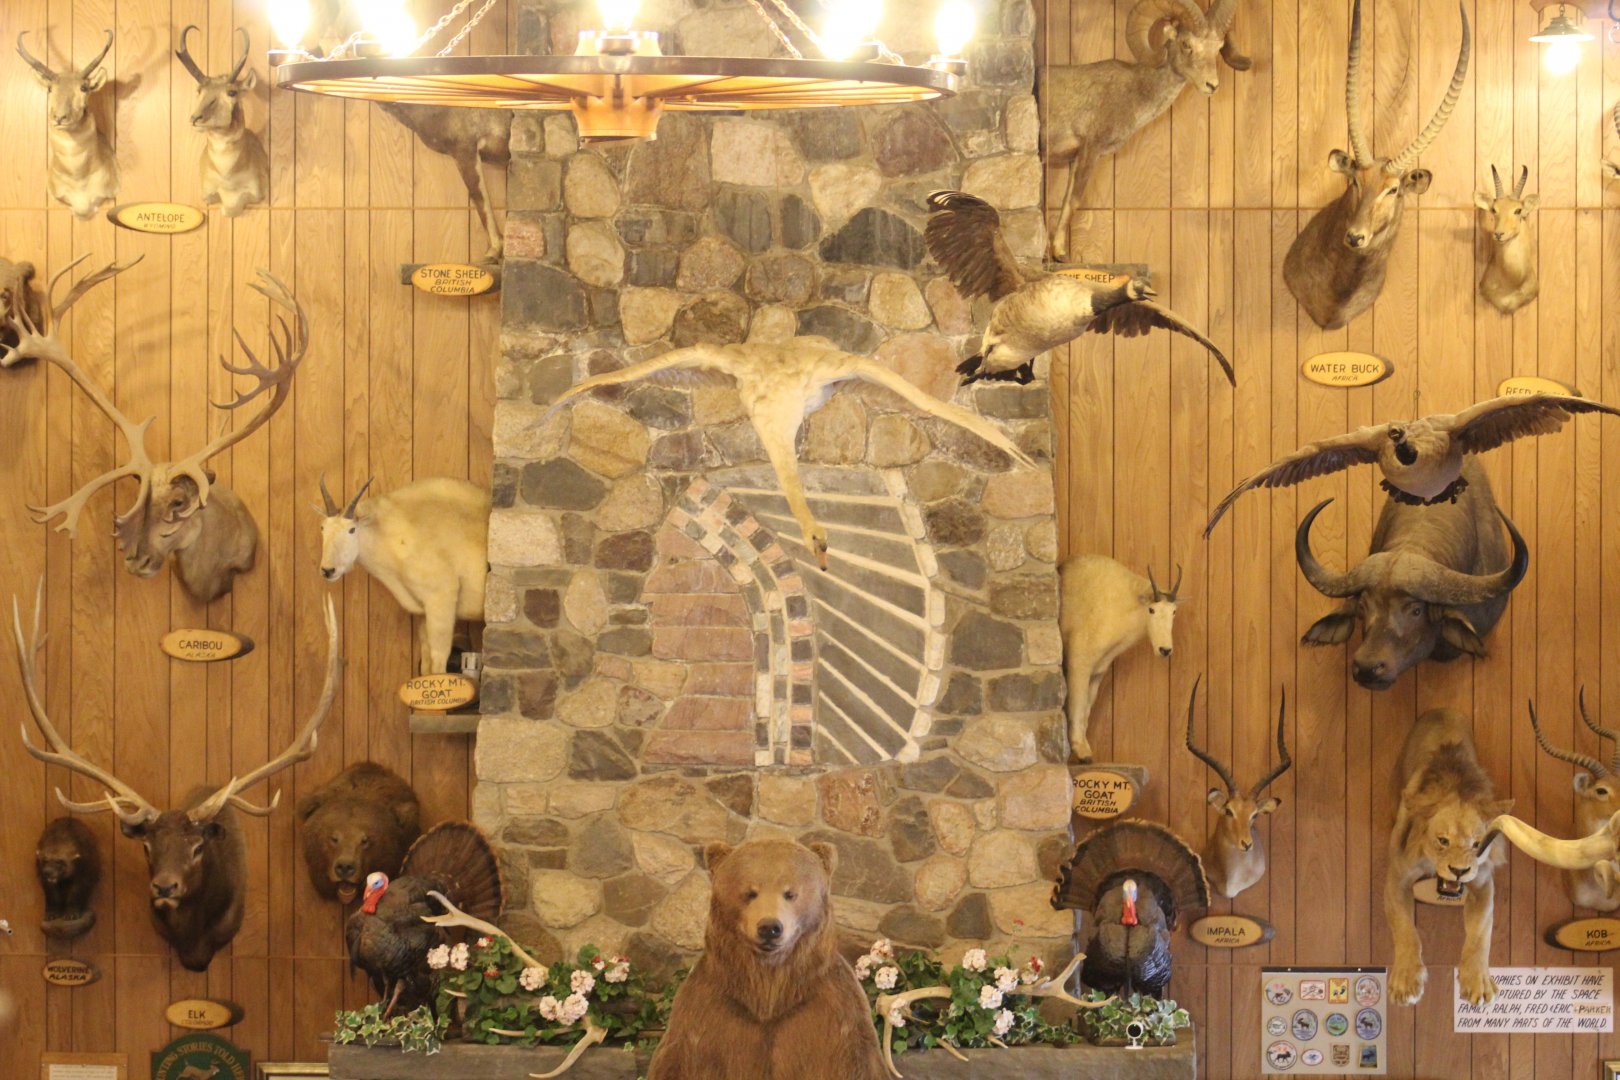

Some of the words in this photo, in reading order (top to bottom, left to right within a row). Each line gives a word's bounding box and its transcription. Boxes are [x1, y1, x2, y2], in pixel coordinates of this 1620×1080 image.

[136, 212, 185, 223] ANTELOPE
[420, 268, 450, 279] STONE
[455, 269, 487, 280] SHEEP
[1084, 273, 1116, 284] SHEEP
[430, 286, 475, 294] COLUMBIA
[1310, 363, 1346, 374] WATER
[1351, 364, 1380, 374] BUCK
[179, 640, 223, 650] CARIBOU
[406, 679, 445, 690] ROCKY
[421, 689, 453, 699] GOAT
[1073, 779, 1109, 790] ROCKY
[1113, 781, 1130, 791] MT.
[1084, 789, 1115, 800] GOAT
[1079, 799, 1117, 807] BRITISH
[1074, 805, 1119, 814] COLUMBIA
[1206, 927, 1246, 937] IMPALA
[1586, 929, 1608, 939] KOB
[48, 973, 87, 981] ALASKA
[1525, 975, 1539, 986] ON
[1541, 975, 1581, 986] EXHIBIT
[1581, 975, 1606, 986] HAVE
[1497, 988, 1532, 1000] PTURED
[1533, 989, 1548, 1000] BY
[1551, 989, 1568, 1000] THE
[1571, 989, 1603, 1000] SPACE
[187, 1010, 206, 1019] ELK
[1492, 1003, 1523, 1016] RALPH,
[1524, 1003, 1549, 1014] FRED
[1457, 1017, 1482, 1028] FROM
[1483, 1017, 1511, 1028] MANY
[1512, 1017, 1539, 1029] PARTS
[1542, 1017, 1555, 1028] OF
[1556, 1017, 1574, 1028] THE
[177, 1042, 212, 1056] STORIES
[213, 1046, 236, 1065] TOLD
